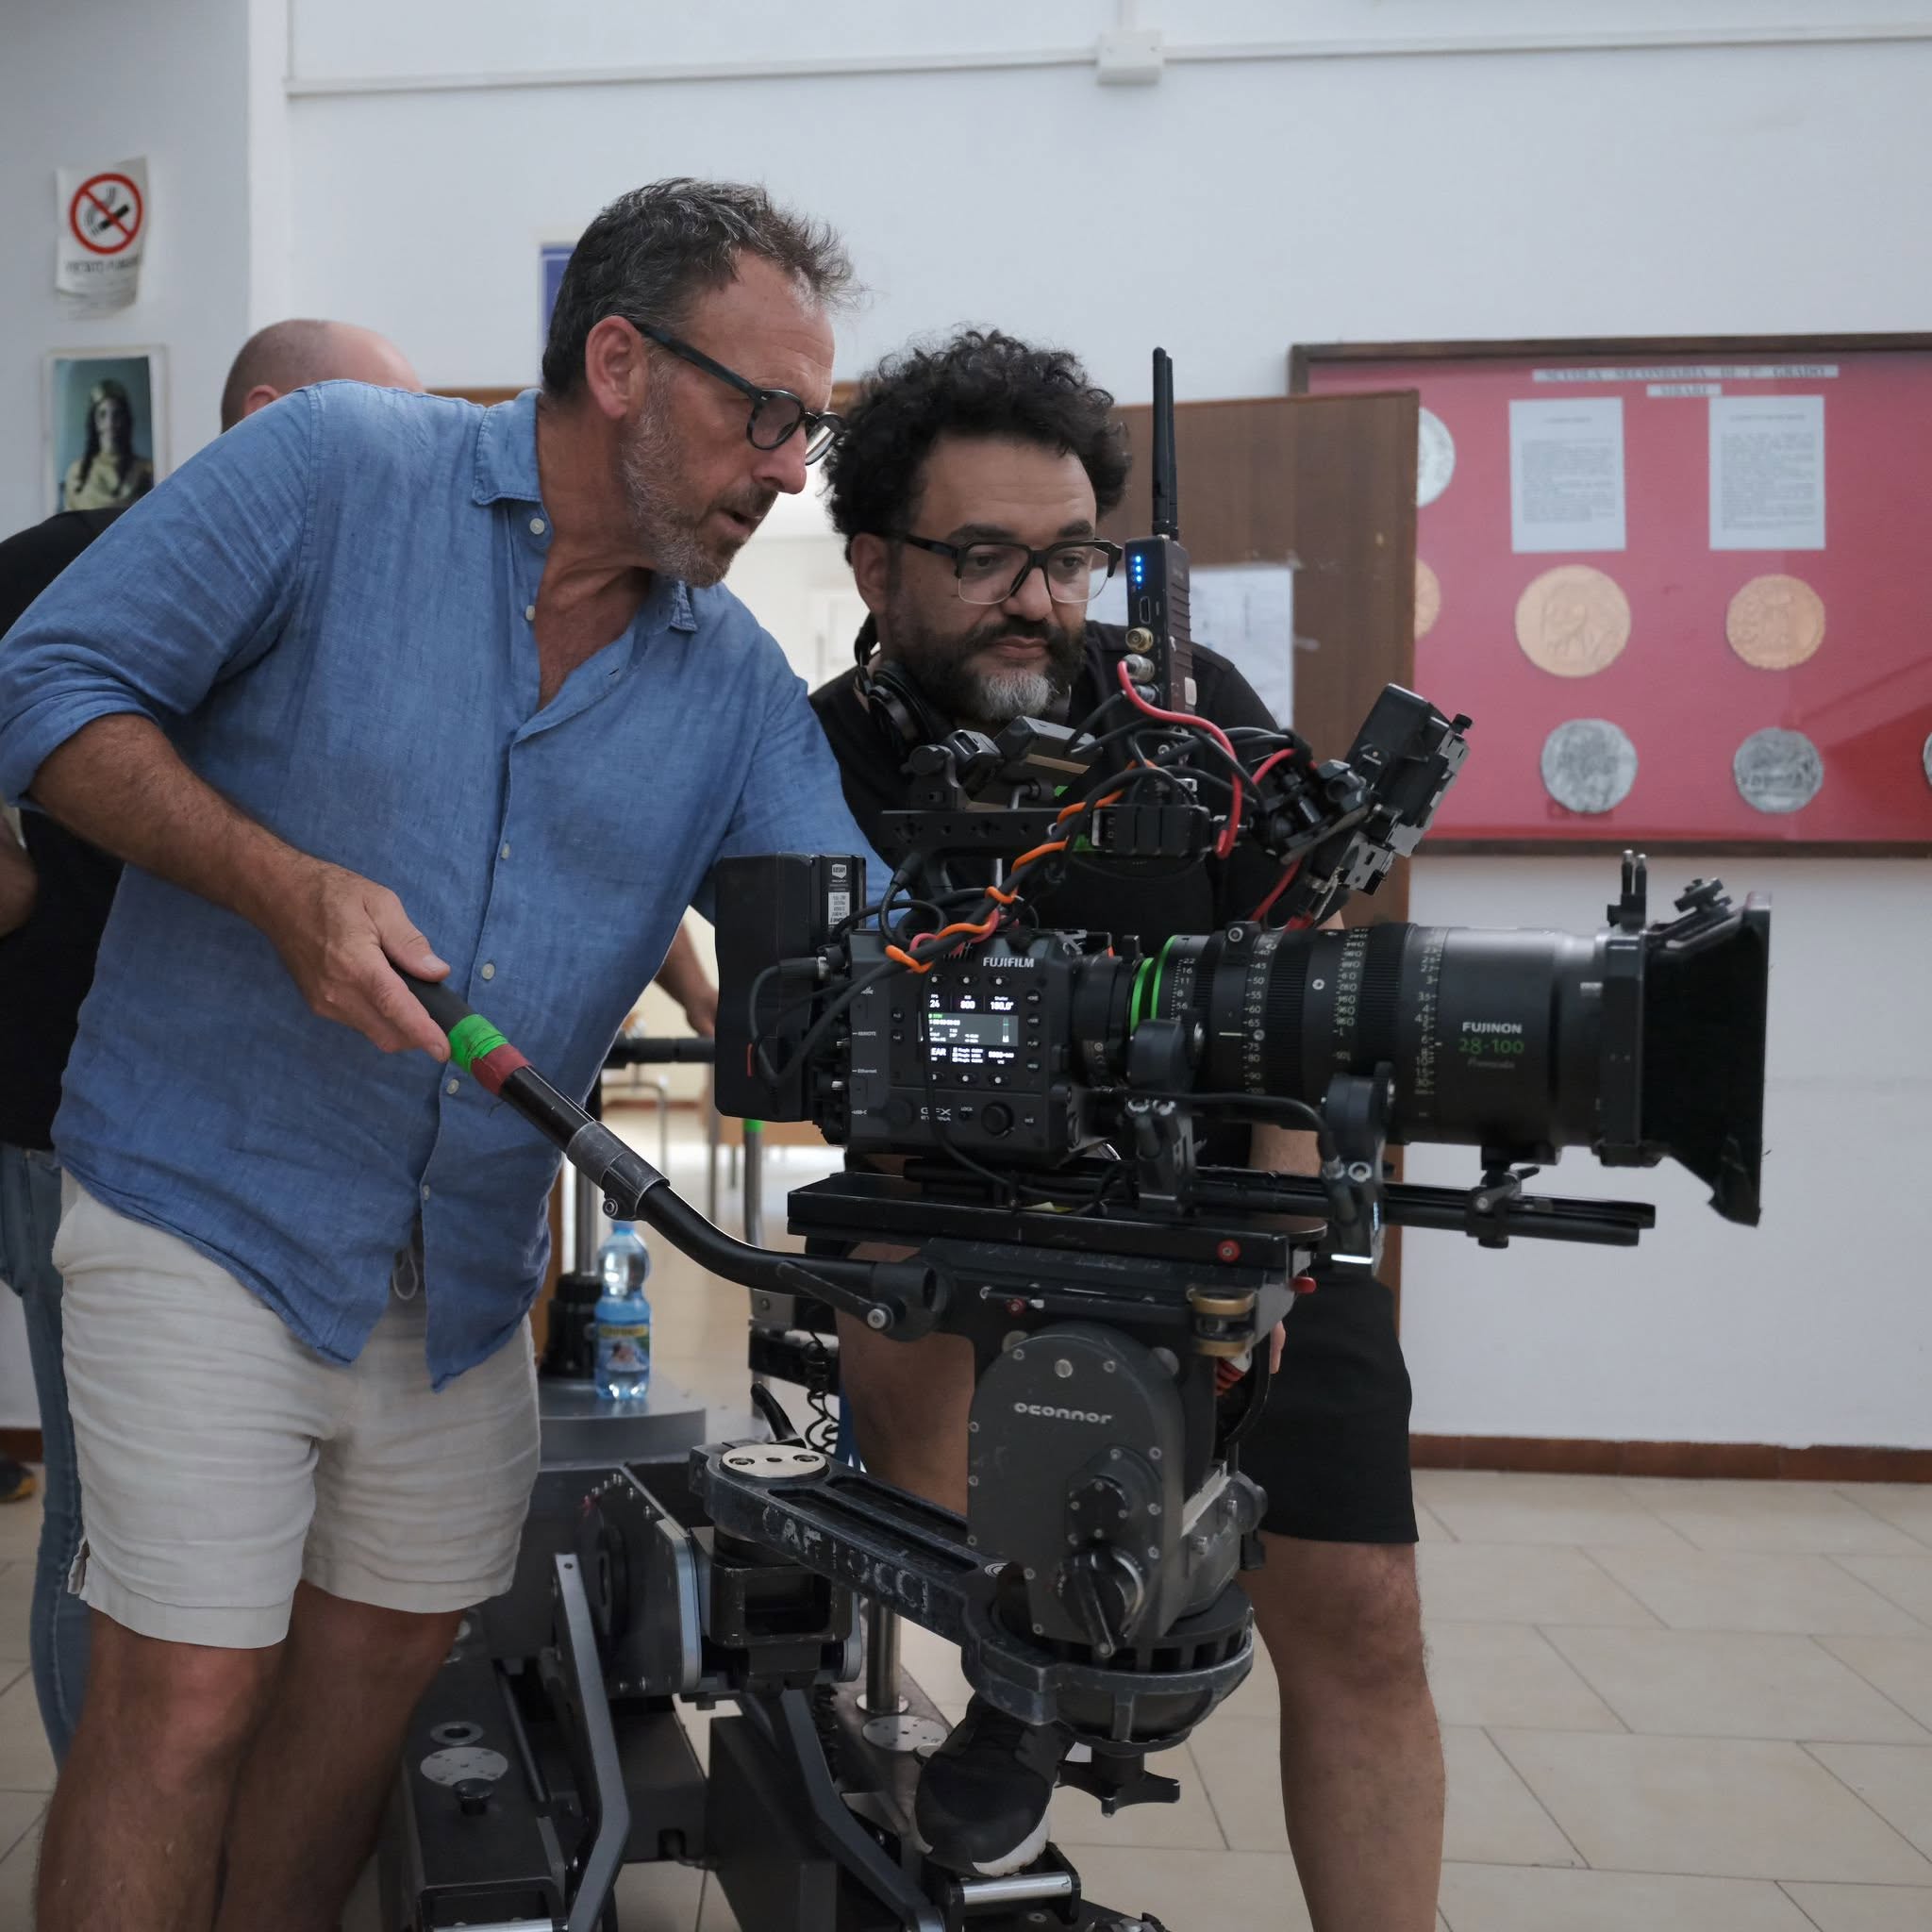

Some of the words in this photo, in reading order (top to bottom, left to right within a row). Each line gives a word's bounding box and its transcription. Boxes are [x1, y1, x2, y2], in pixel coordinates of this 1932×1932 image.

[983, 957, 1035, 968] FUJIFILM
[1253, 976, 1265, 985] 50
[1250, 991, 1262, 1000] 55
[1249, 1006, 1261, 1014] 60
[1248, 1019, 1260, 1027] 65
[1462, 1022, 1523, 1035] FUJINON
[1248, 1042, 1260, 1052] 75
[1457, 1037, 1524, 1056] 28-100
[1248, 1054, 1261, 1062] 80
